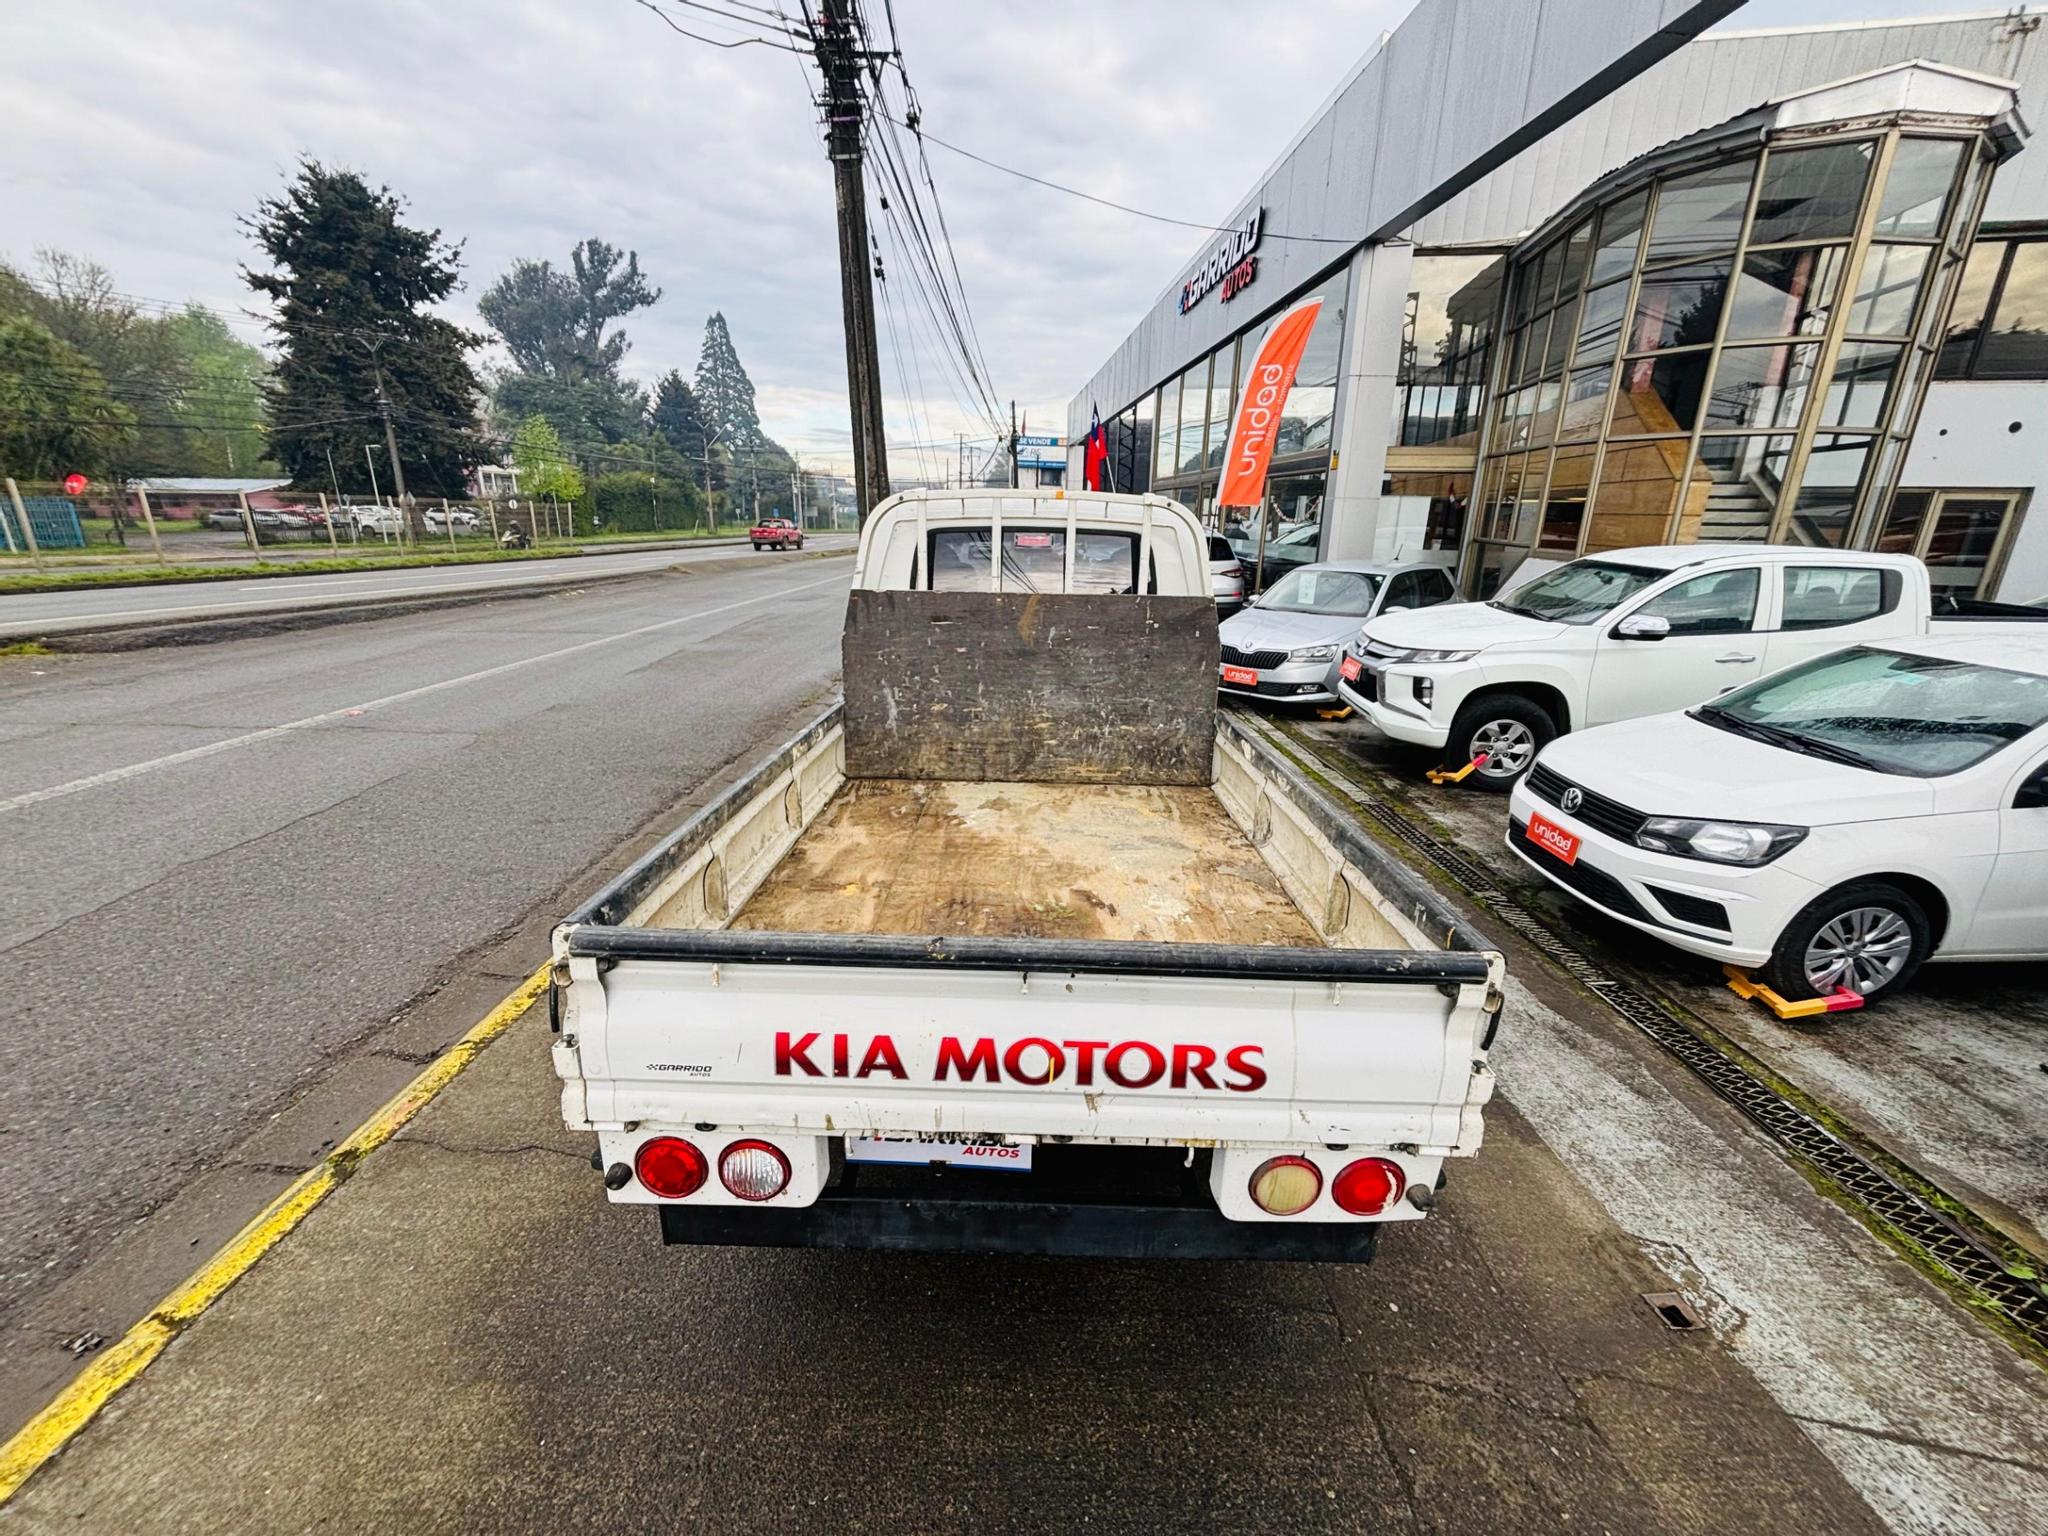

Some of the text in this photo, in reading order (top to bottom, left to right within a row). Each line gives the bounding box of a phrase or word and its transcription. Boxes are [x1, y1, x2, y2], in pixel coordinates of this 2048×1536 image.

[1188, 206, 1264, 308] GARRIDO
[1220, 256, 1256, 304] AUTOS
[1238, 363, 1284, 477] unidad
[1028, 437, 1051, 445] VENDE
[1533, 821, 1573, 852] unidad
[658, 1063, 713, 1073] GARRIDO
[773, 1031, 1269, 1093] KIA MOTORS
[962, 1146, 1020, 1159] AUTOS
